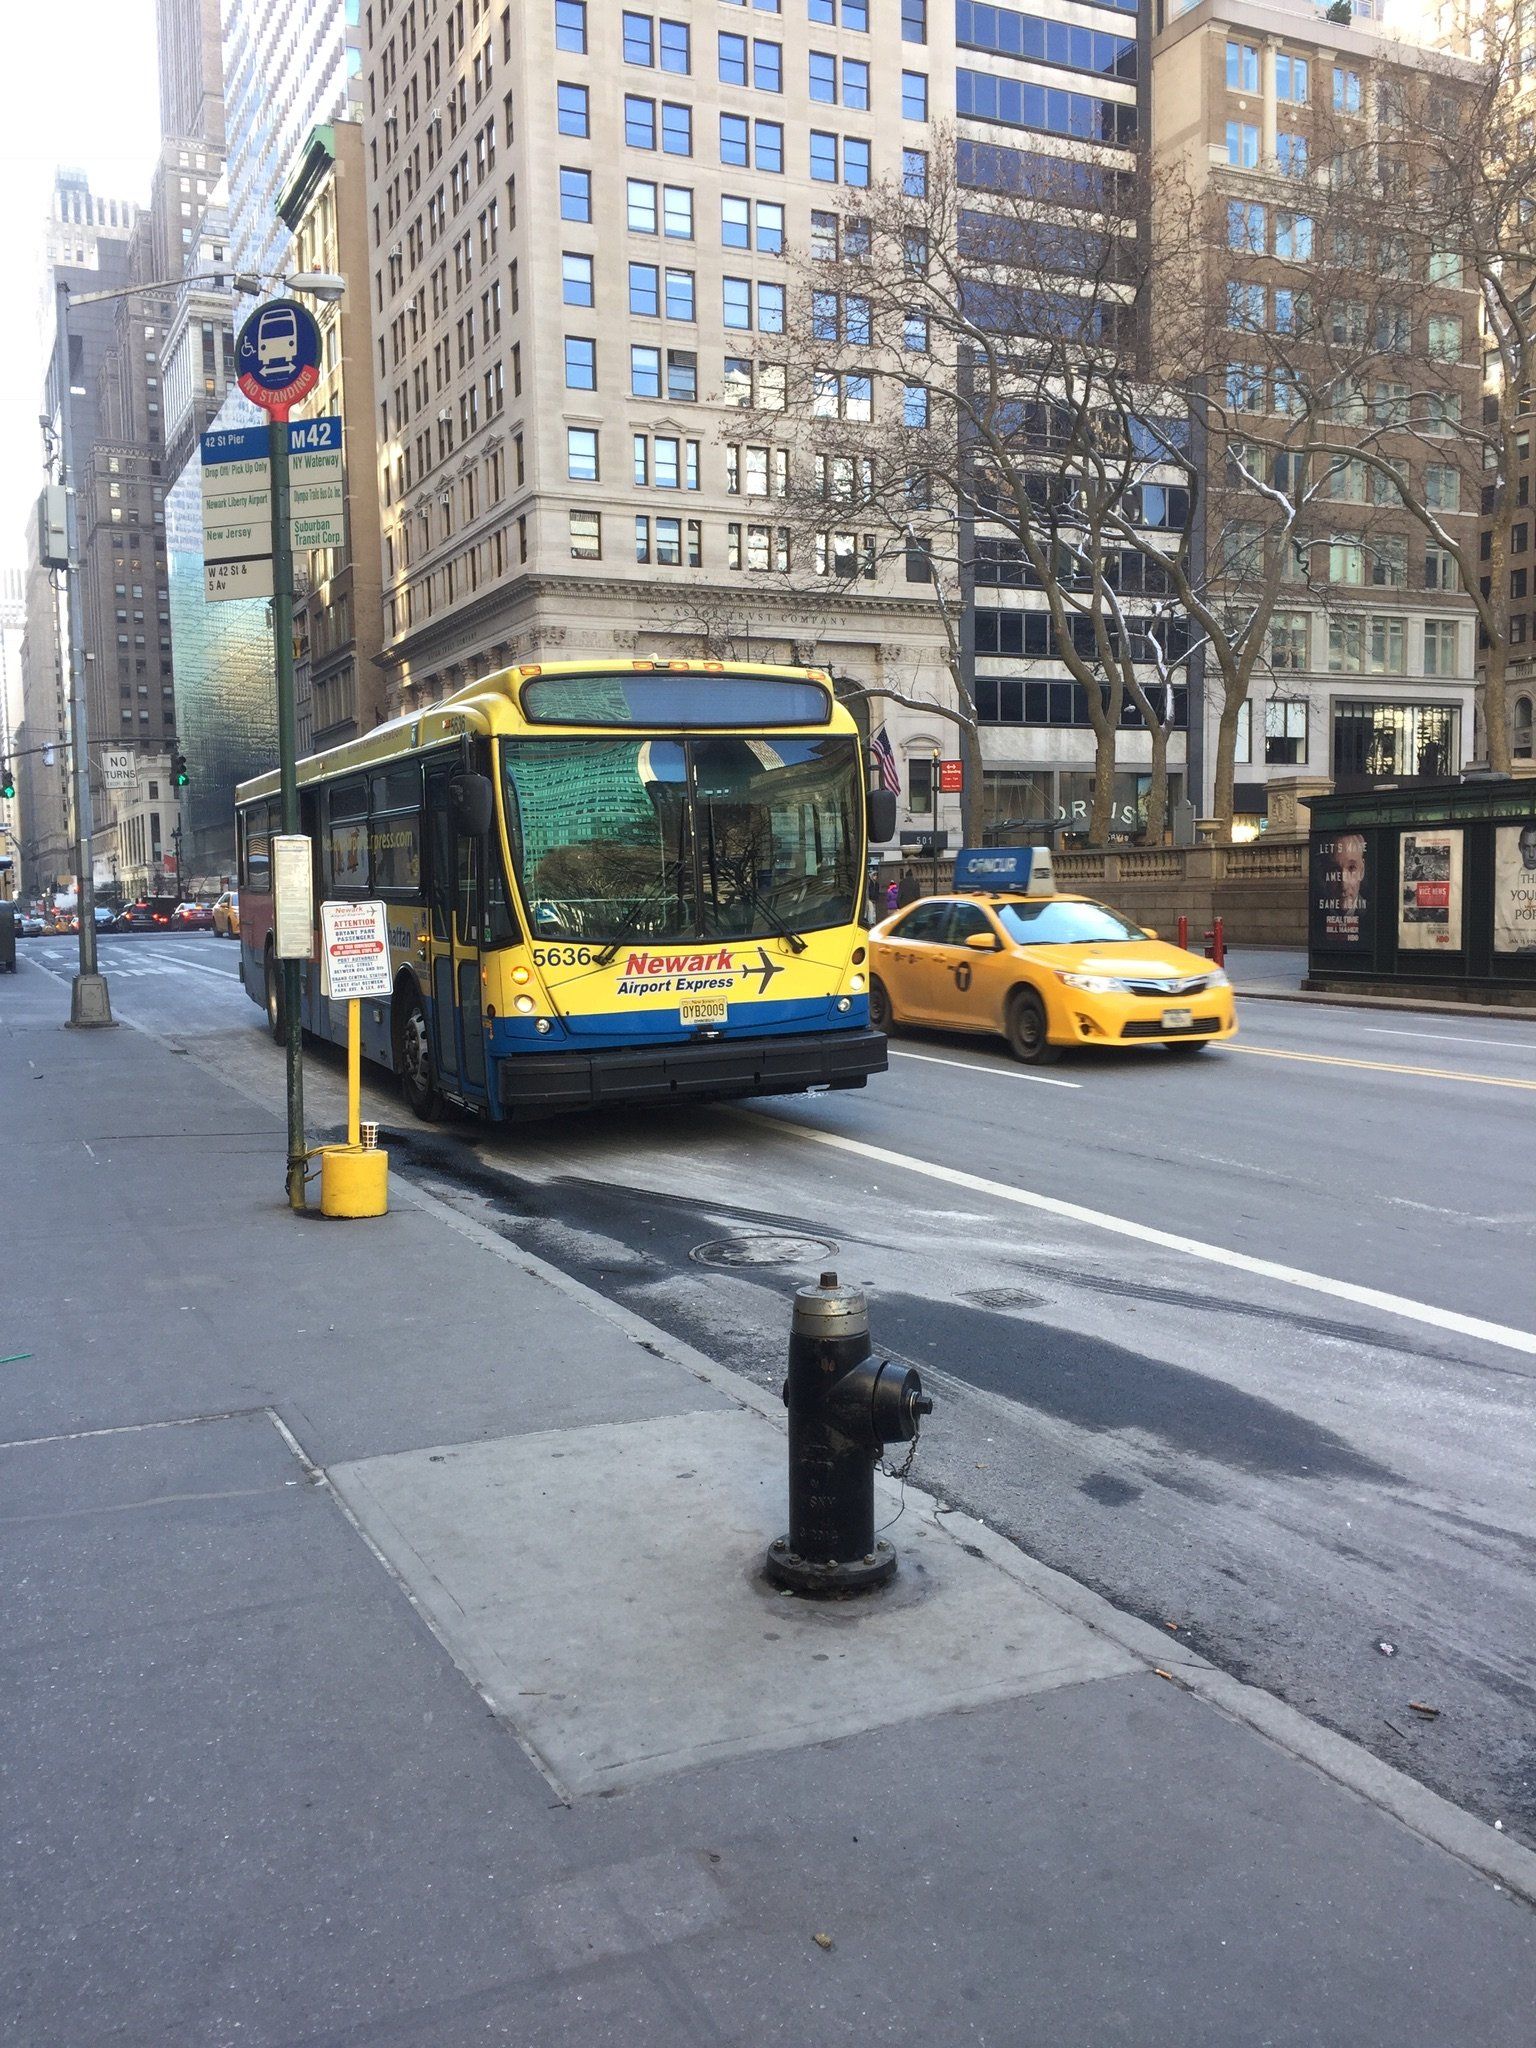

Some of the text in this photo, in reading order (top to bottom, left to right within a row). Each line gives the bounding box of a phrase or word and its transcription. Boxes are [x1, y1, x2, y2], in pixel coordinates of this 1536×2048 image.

[244, 371, 312, 403] NO STANDING
[205, 434, 244, 447] 42 St Pier
[291, 422, 331, 449] M42
[293, 455, 339, 470] NY Waterway
[205, 468, 218, 479] Drop
[232, 464, 244, 475] Pick
[245, 463, 253, 475] Up
[255, 461, 267, 473] Only
[206, 494, 268, 510] Newark Liberty Airport
[295, 519, 330, 533] Suburban
[207, 528, 251, 541] New Jersey
[295, 532, 321, 546] Transit
[208, 564, 247, 577] W 42 St &
[209, 580, 226, 591] 5 Av
[781, 612, 847, 626] COMPANY
[110, 756, 127, 767] NO
[105, 770, 136, 779] TURNS
[1058, 799, 1136, 824] ORIS
[916, 836, 932, 845] 501
[1511, 890, 1536, 901] YOU
[335, 906, 363, 914] Newark
[334, 918, 375, 928] ATTENTION
[337, 934, 375, 942] PASSENGERS
[388, 923, 411, 949] hattan
[533, 947, 591, 967] 5636
[626, 948, 735, 975] Newark
[617, 977, 734, 996] Airport Express
